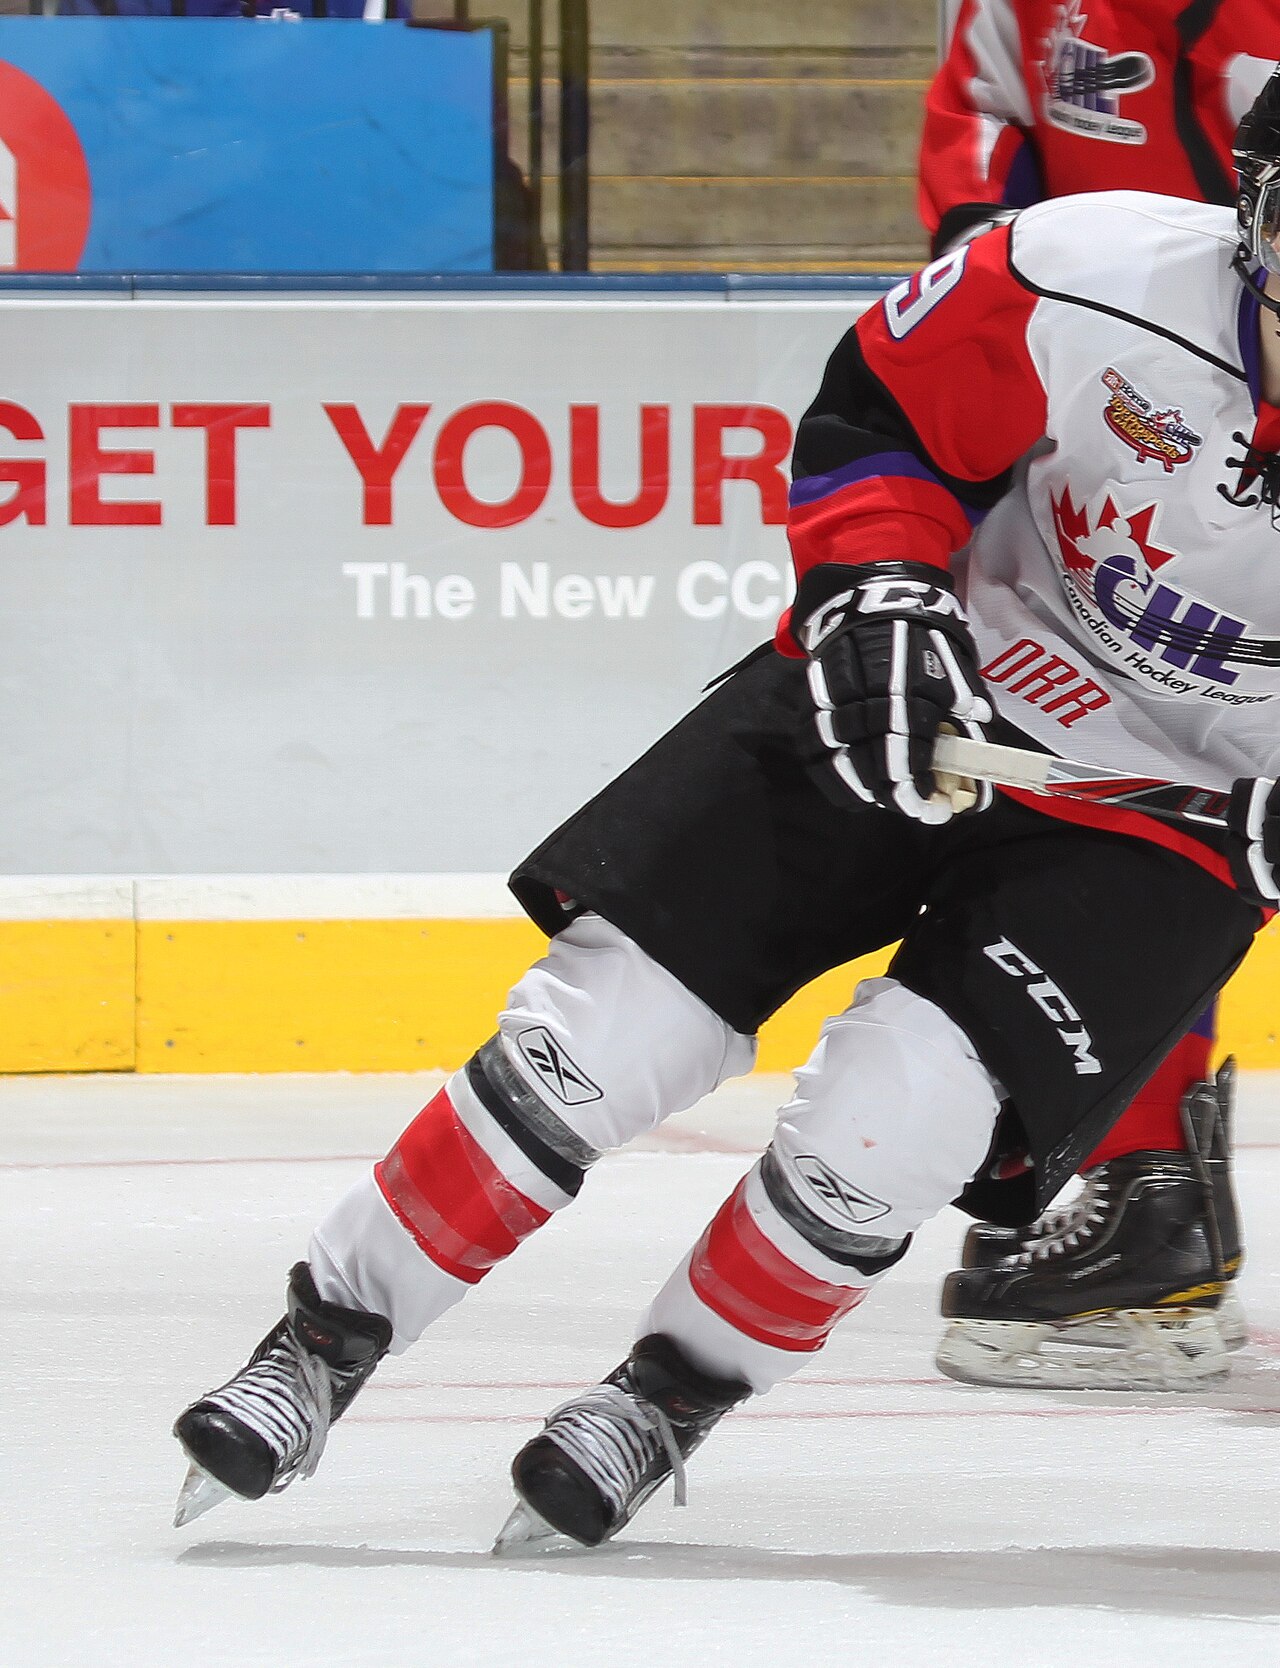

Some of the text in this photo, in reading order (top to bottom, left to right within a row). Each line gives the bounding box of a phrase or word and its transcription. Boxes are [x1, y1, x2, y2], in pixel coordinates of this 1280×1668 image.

[884, 244, 970, 341] 9
[321, 401, 795, 528] YOUR
[342, 560, 797, 619] The New CC
[1063, 574, 1123, 653] Canadian
[1124, 651, 1199, 694] Hockey
[1096, 555, 1248, 686] CHL
[978, 639, 1112, 728] ORR
[983, 935, 1103, 1075] CCM
